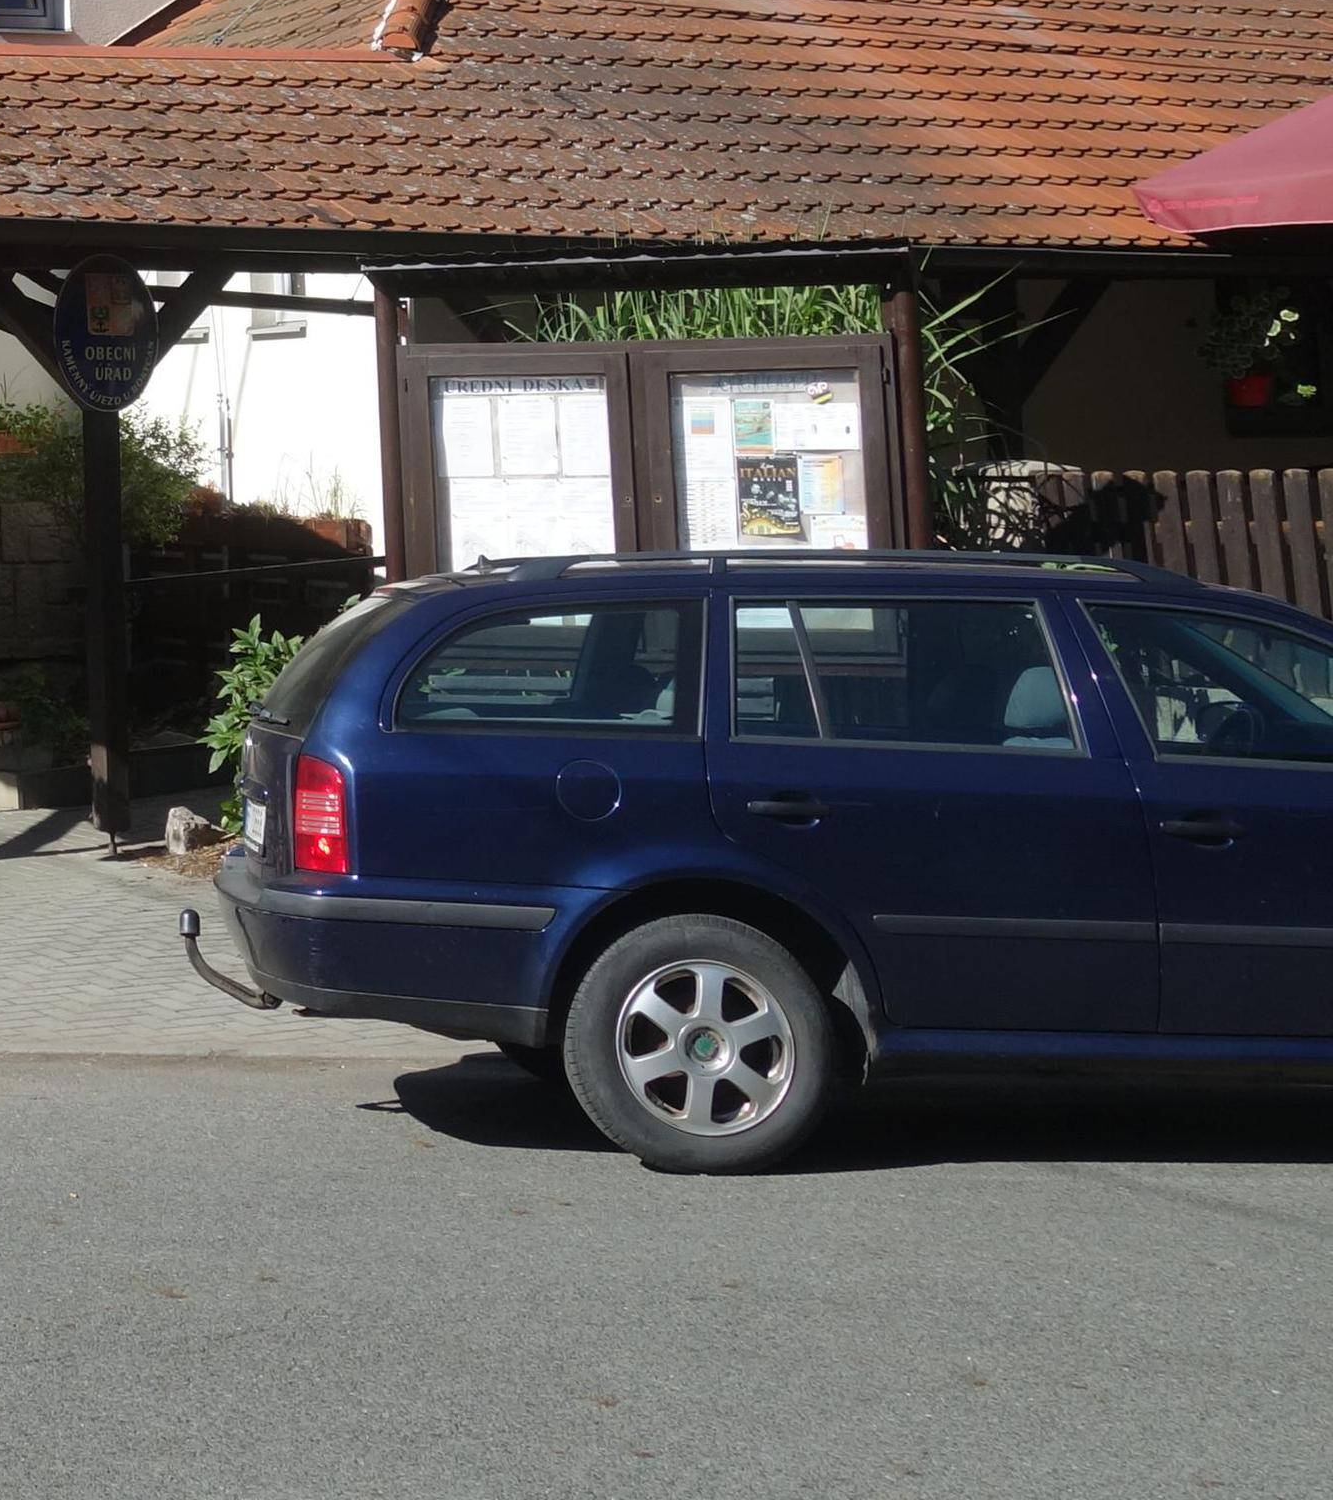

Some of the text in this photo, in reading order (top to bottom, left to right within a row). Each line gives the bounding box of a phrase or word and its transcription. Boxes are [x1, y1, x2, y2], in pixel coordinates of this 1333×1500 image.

[95, 362, 132, 381] ÚŘAD
[523, 378, 583, 392] DESKA
[740, 467, 797, 479] ITALIAN
